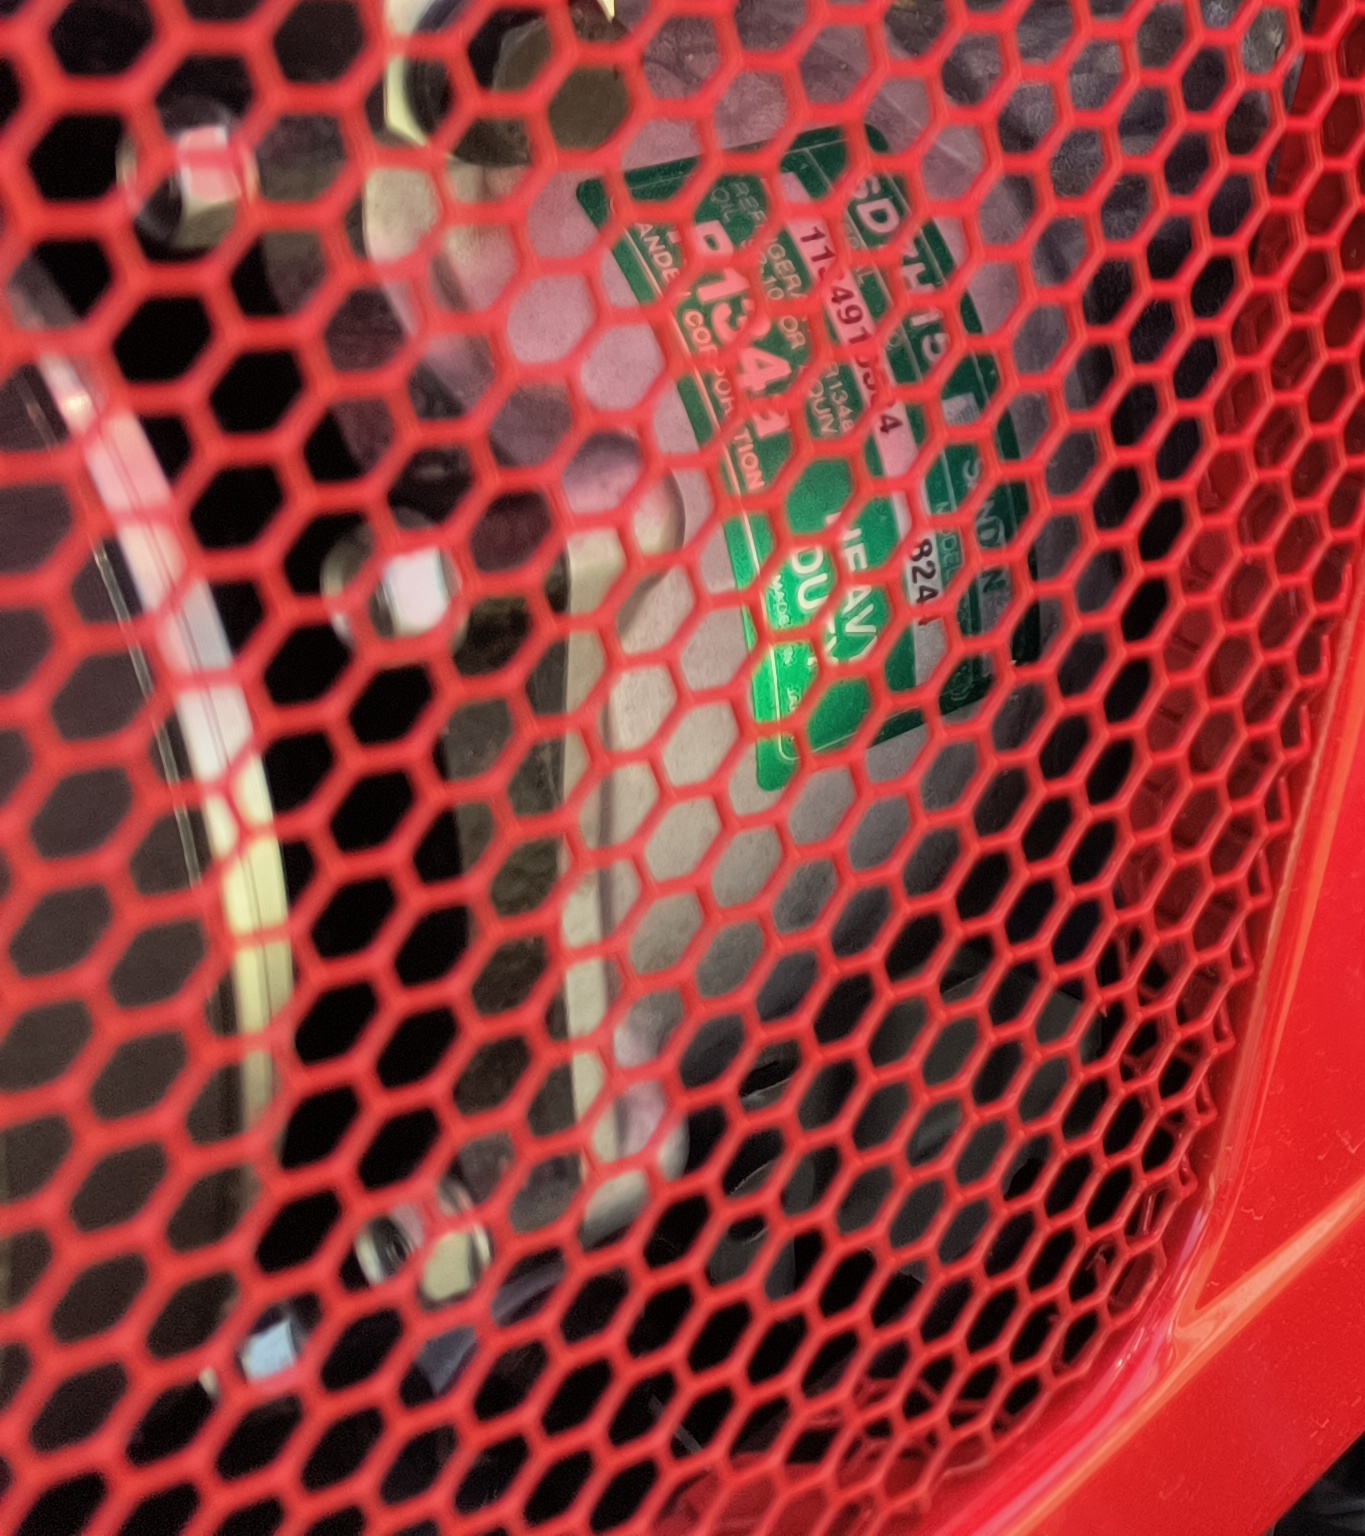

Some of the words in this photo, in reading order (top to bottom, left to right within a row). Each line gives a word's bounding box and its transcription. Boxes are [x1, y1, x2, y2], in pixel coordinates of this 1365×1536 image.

[683, 308, 765, 490] CORPORTION
[778, 313, 806, 350] OR
[798, 362, 838, 433] QUIV
[908, 538, 941, 626] 824
